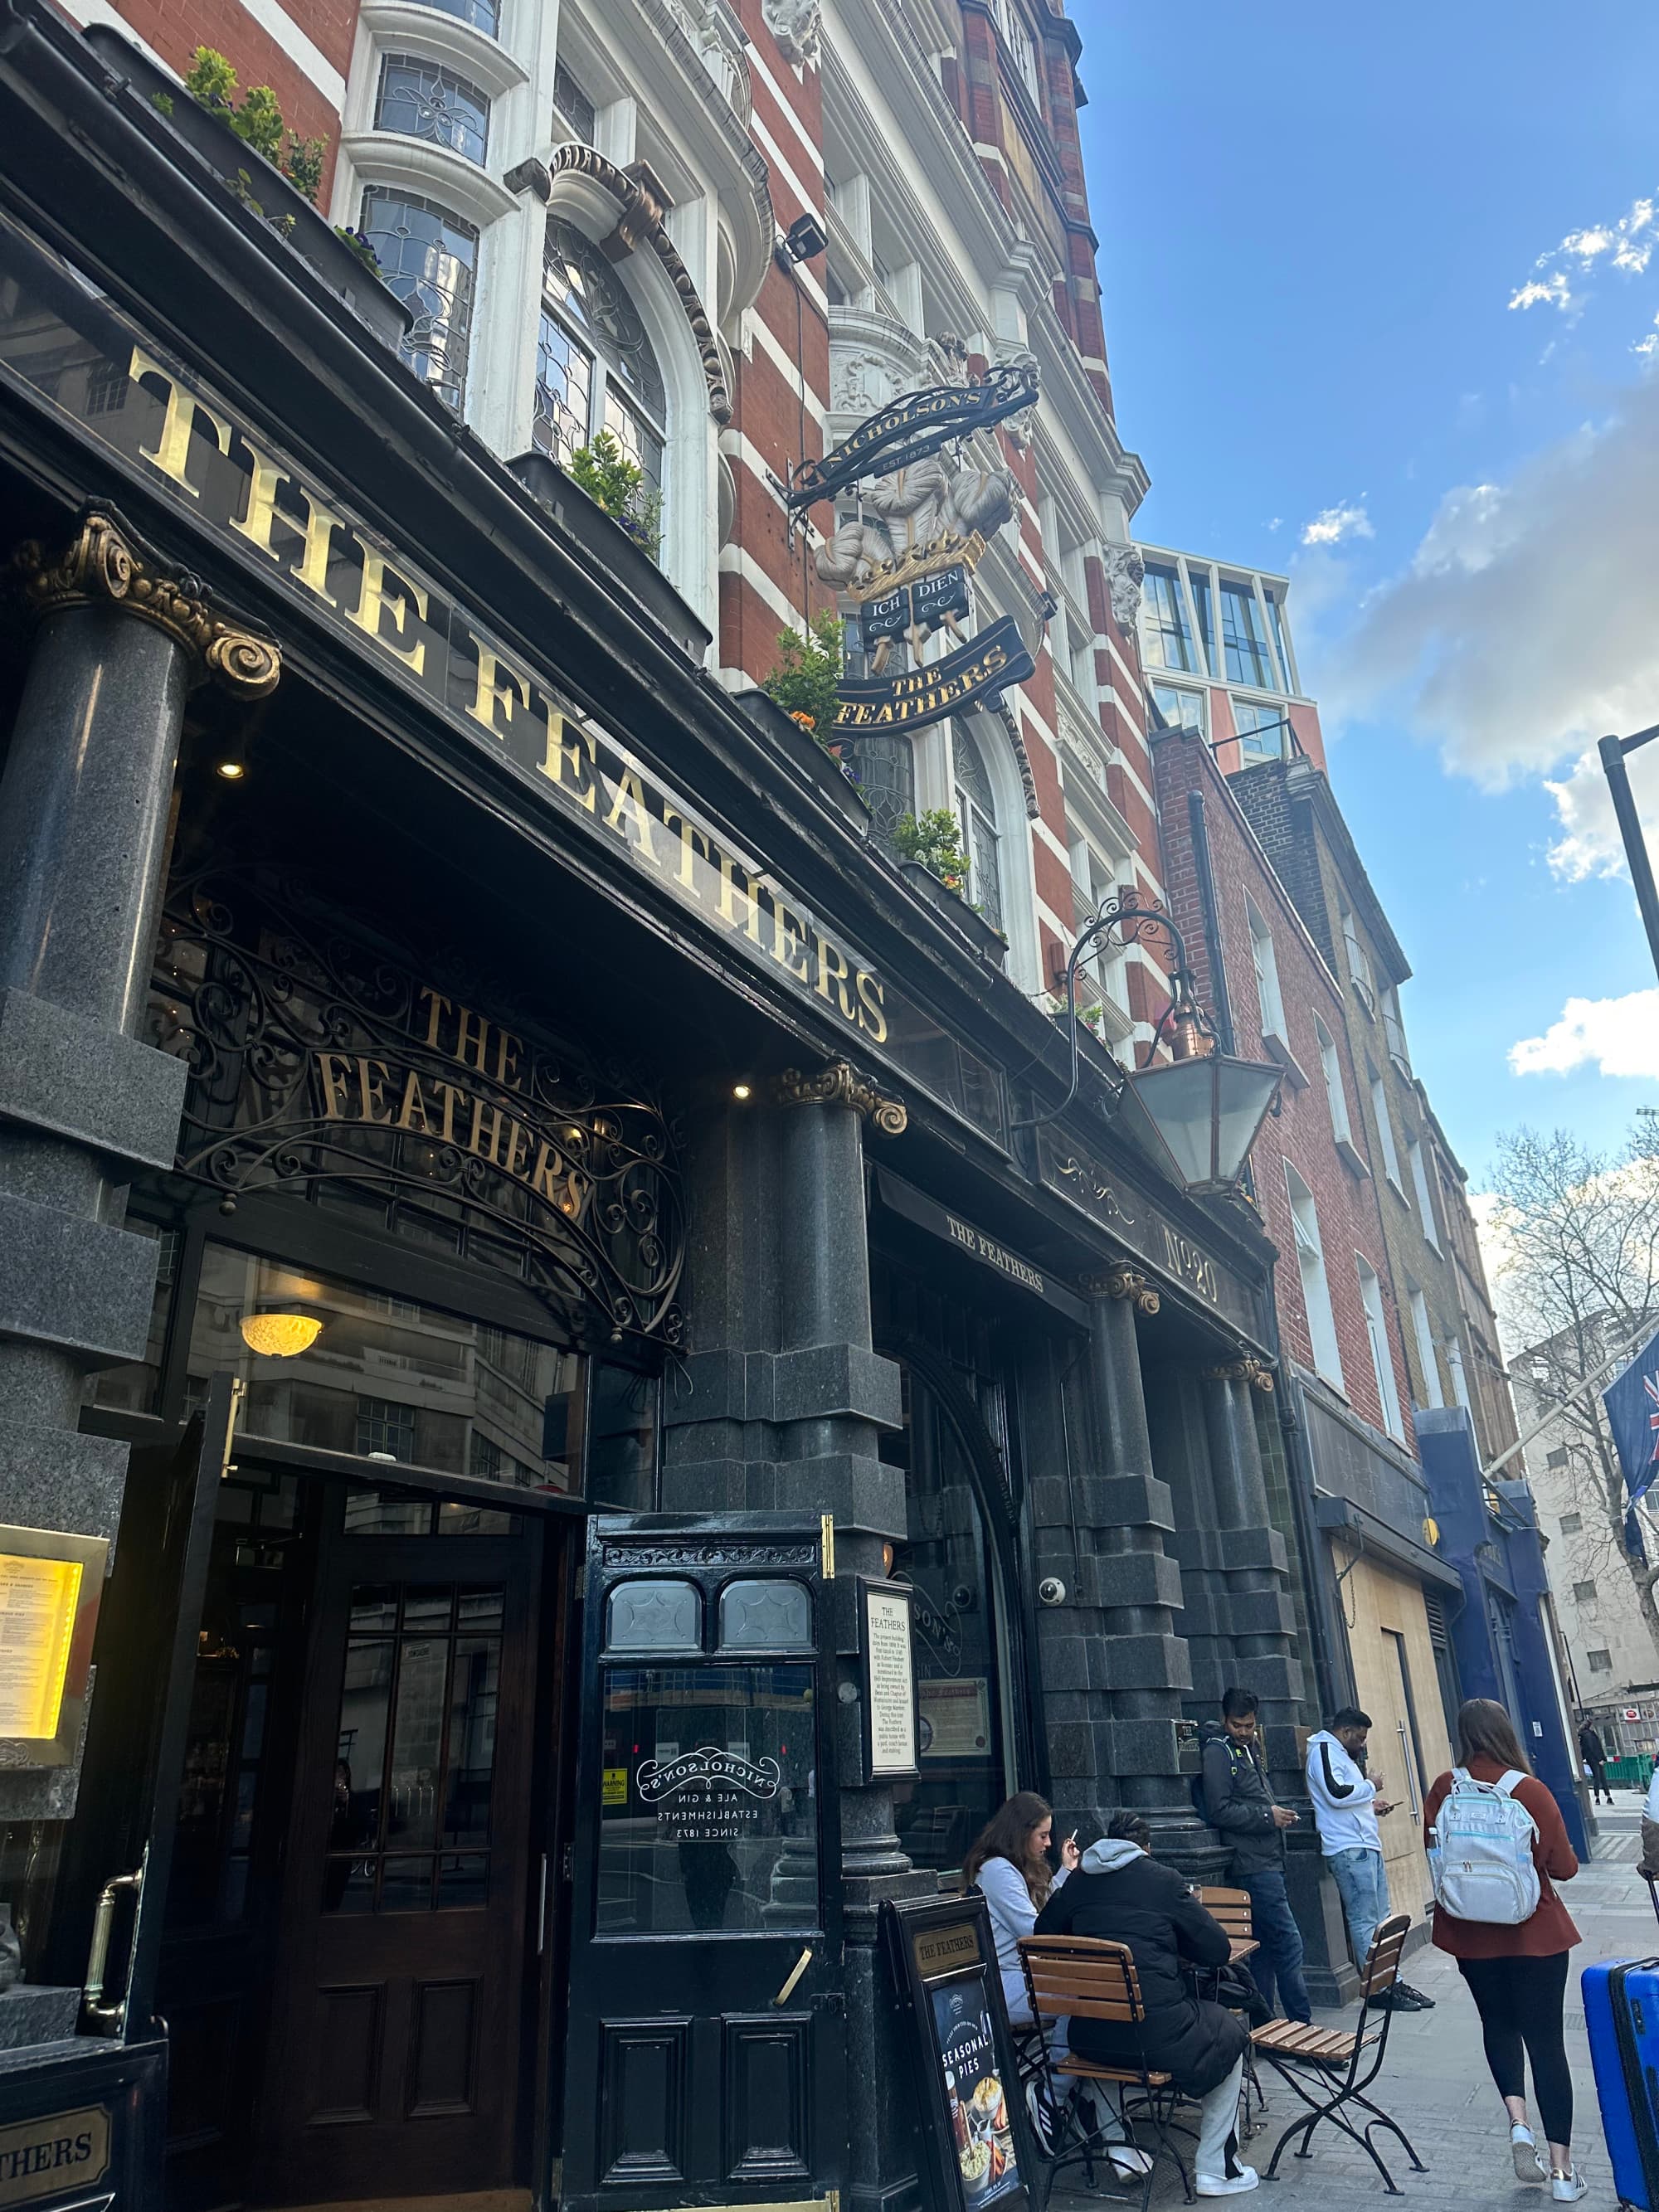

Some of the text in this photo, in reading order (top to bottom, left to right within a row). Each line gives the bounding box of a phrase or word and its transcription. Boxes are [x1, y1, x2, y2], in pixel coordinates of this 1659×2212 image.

[828, 391, 981, 469] NICHOLSON'S
[873, 570, 960, 617] ICH DIEN
[129, 345, 888, 1043] THE FEATHERS
[832, 649, 1007, 724] FEATHERS
[892, 665, 942, 697] THE
[420, 986, 524, 1091] THE
[314, 1052, 589, 1217] FEATHERS
[946, 1215, 1044, 1292] THE FEATHERS
[871, 1617, 906, 1631] FEATHERS
[882, 1607, 893, 1616] THE
[919, 1935, 974, 1960] THE FEATHERS
[942, 2034, 988, 2067] SEASONAL
[959, 2058, 979, 2078] PIES
